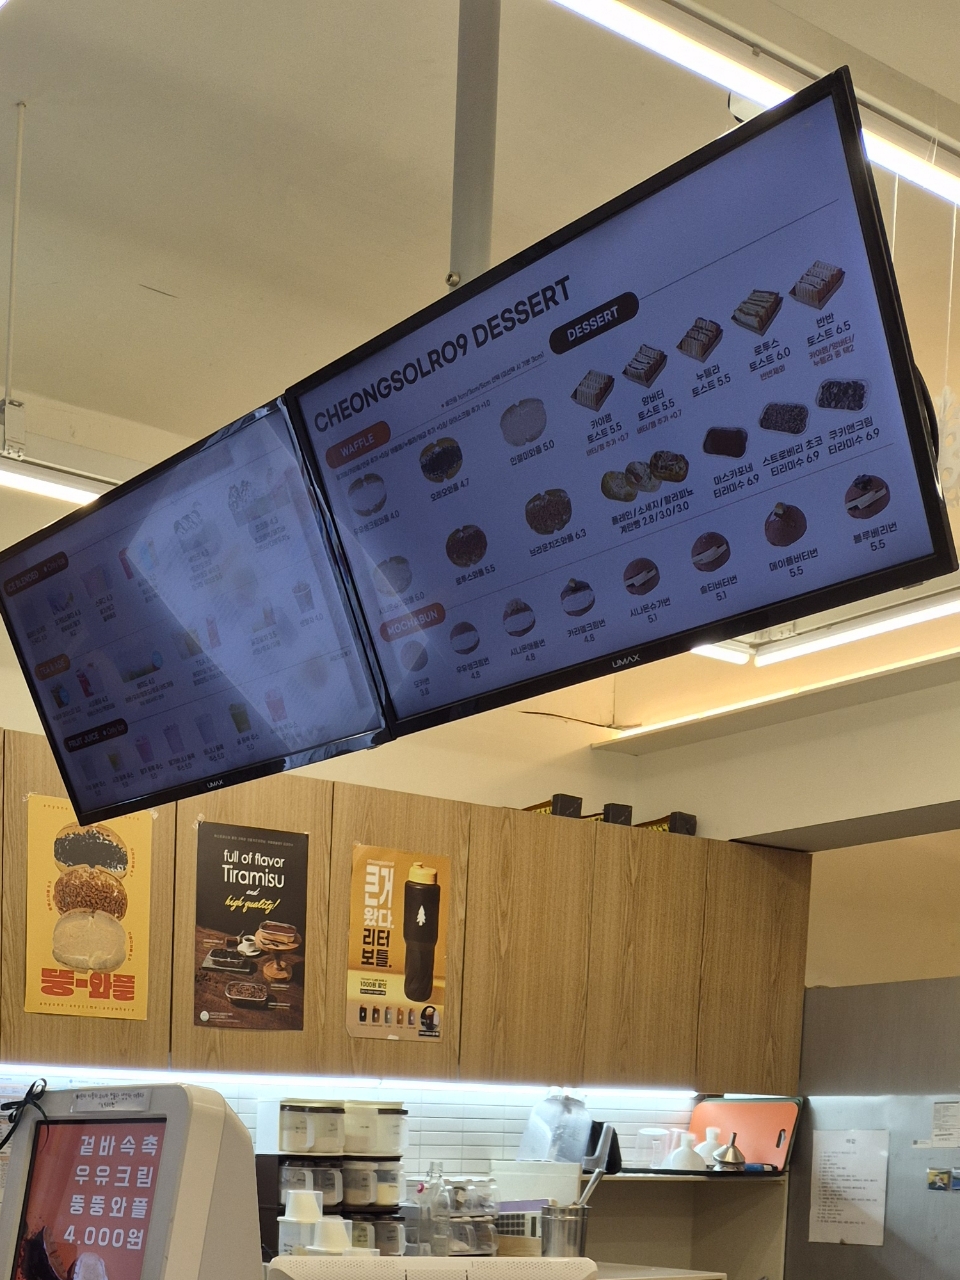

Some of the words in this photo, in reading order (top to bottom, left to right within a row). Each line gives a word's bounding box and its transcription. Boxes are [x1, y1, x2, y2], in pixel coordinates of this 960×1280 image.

[567, 306, 619, 342] DESSERT
[815, 312, 835, 329] 반반
[806, 328, 834, 348] 토스트
[835, 320, 851, 335] 6.5
[313, 332, 469, 433] CHEONGSOLRO9
[471, 275, 571, 348] DESSERT
[753, 338, 780, 357] 로투스
[749, 354, 775, 373] 토스트
[775, 346, 791, 361] 6.0
[695, 363, 721, 382] 누텔라
[691, 381, 716, 398] 토스트
[716, 373, 731, 388] 5.5
[641, 388, 665, 407] 앙버터
[637, 405, 661, 422] 토스트
[660, 398, 675, 412] 5.5
[590, 413, 613, 430] 카야잼
[829, 416, 874, 441] 쿠키앤크림
[586, 428, 608, 445] 토스트
[608, 421, 623, 435] 5.5
[828, 436, 864, 455] 티라미수
[865, 428, 880, 442] 6.9
[340, 433, 375, 457] WAFFLE
[509, 444, 543, 466] 인절미와플
[542, 440, 555, 452] 5.0
[762, 444, 804, 467] 스트로베리
[806, 436, 823, 450] 초코
[713, 463, 754, 485] 마스카포네
[771, 458, 804, 476] 티라미수
[806, 451, 820, 465] 6.9
[460, 478, 470, 490] 4.7
[714, 480, 745, 498] 티라미수
[747, 474, 760, 488] 6.9
[389, 510, 400, 521] 4.0
[529, 533, 575, 557] 브라운치즈와플
[575, 528, 587, 540] 6.3
[853, 522, 898, 544] 블루베리번
[870, 538, 886, 552] 5.5
[485, 564, 496, 575] 5.5
[769, 548, 819, 571] 메이플버터번
[789, 565, 803, 577] 5.5
[716, 589, 727, 601] 5.1
[630, 597, 671, 617] 시나몬슈가번
[387, 609, 438, 636] MOCHABUN
[647, 613, 658, 624] 5.1
[583, 633, 595, 643] 4.8
[525, 652, 536, 662] 4.8
[611, 653, 641, 668] UMAX
[470, 670, 481, 680] 4.8
[68, 735, 83, 748] FRUIT
[84, 731, 100, 743] JUICE
[206, 778, 224, 789] UMAX
[224, 849, 239, 863] full
[241, 851, 253, 865] of
[255, 852, 285, 868] flavor
[222, 864, 285, 888] Tiramisu
[364, 864, 395, 908] 큰거
[246, 887, 261, 896] and
[225, 895, 244, 911] high
[243, 898, 281, 915] quality!
[364, 907, 394, 929] 왔다.
[363, 928, 391, 948] 리터
[361, 948, 392, 969] 보틀.
[80, 1135, 159, 1156] 겉바속촉
[75, 1165, 153, 1188] 우유크림
[64, 1225, 144, 1250] 4.000원
